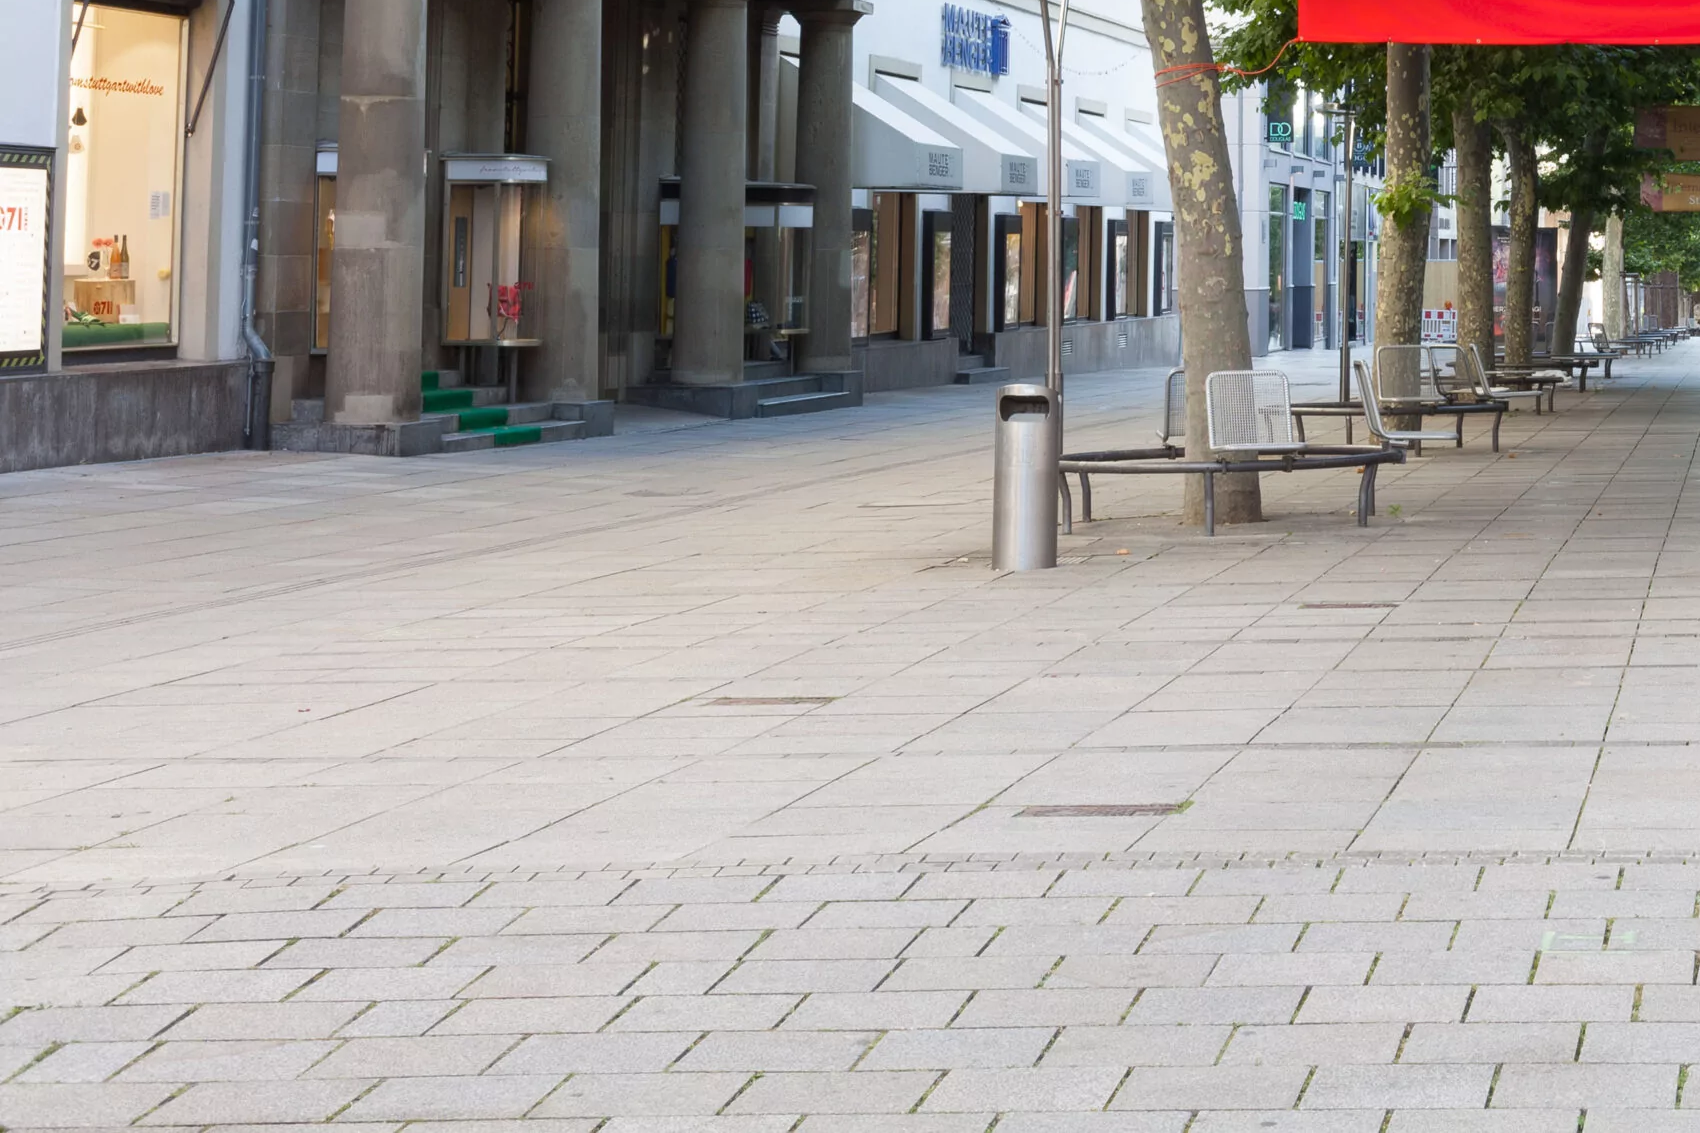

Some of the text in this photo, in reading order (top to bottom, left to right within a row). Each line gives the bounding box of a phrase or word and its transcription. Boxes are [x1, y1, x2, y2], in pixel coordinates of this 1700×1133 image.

[943, 2, 992, 40] MAUTE
[943, 34, 992, 72] BENGER
[929, 152, 949, 166] MAUTE
[928, 164, 949, 178] BENGER
[1009, 162, 1026, 174] MAUTE
